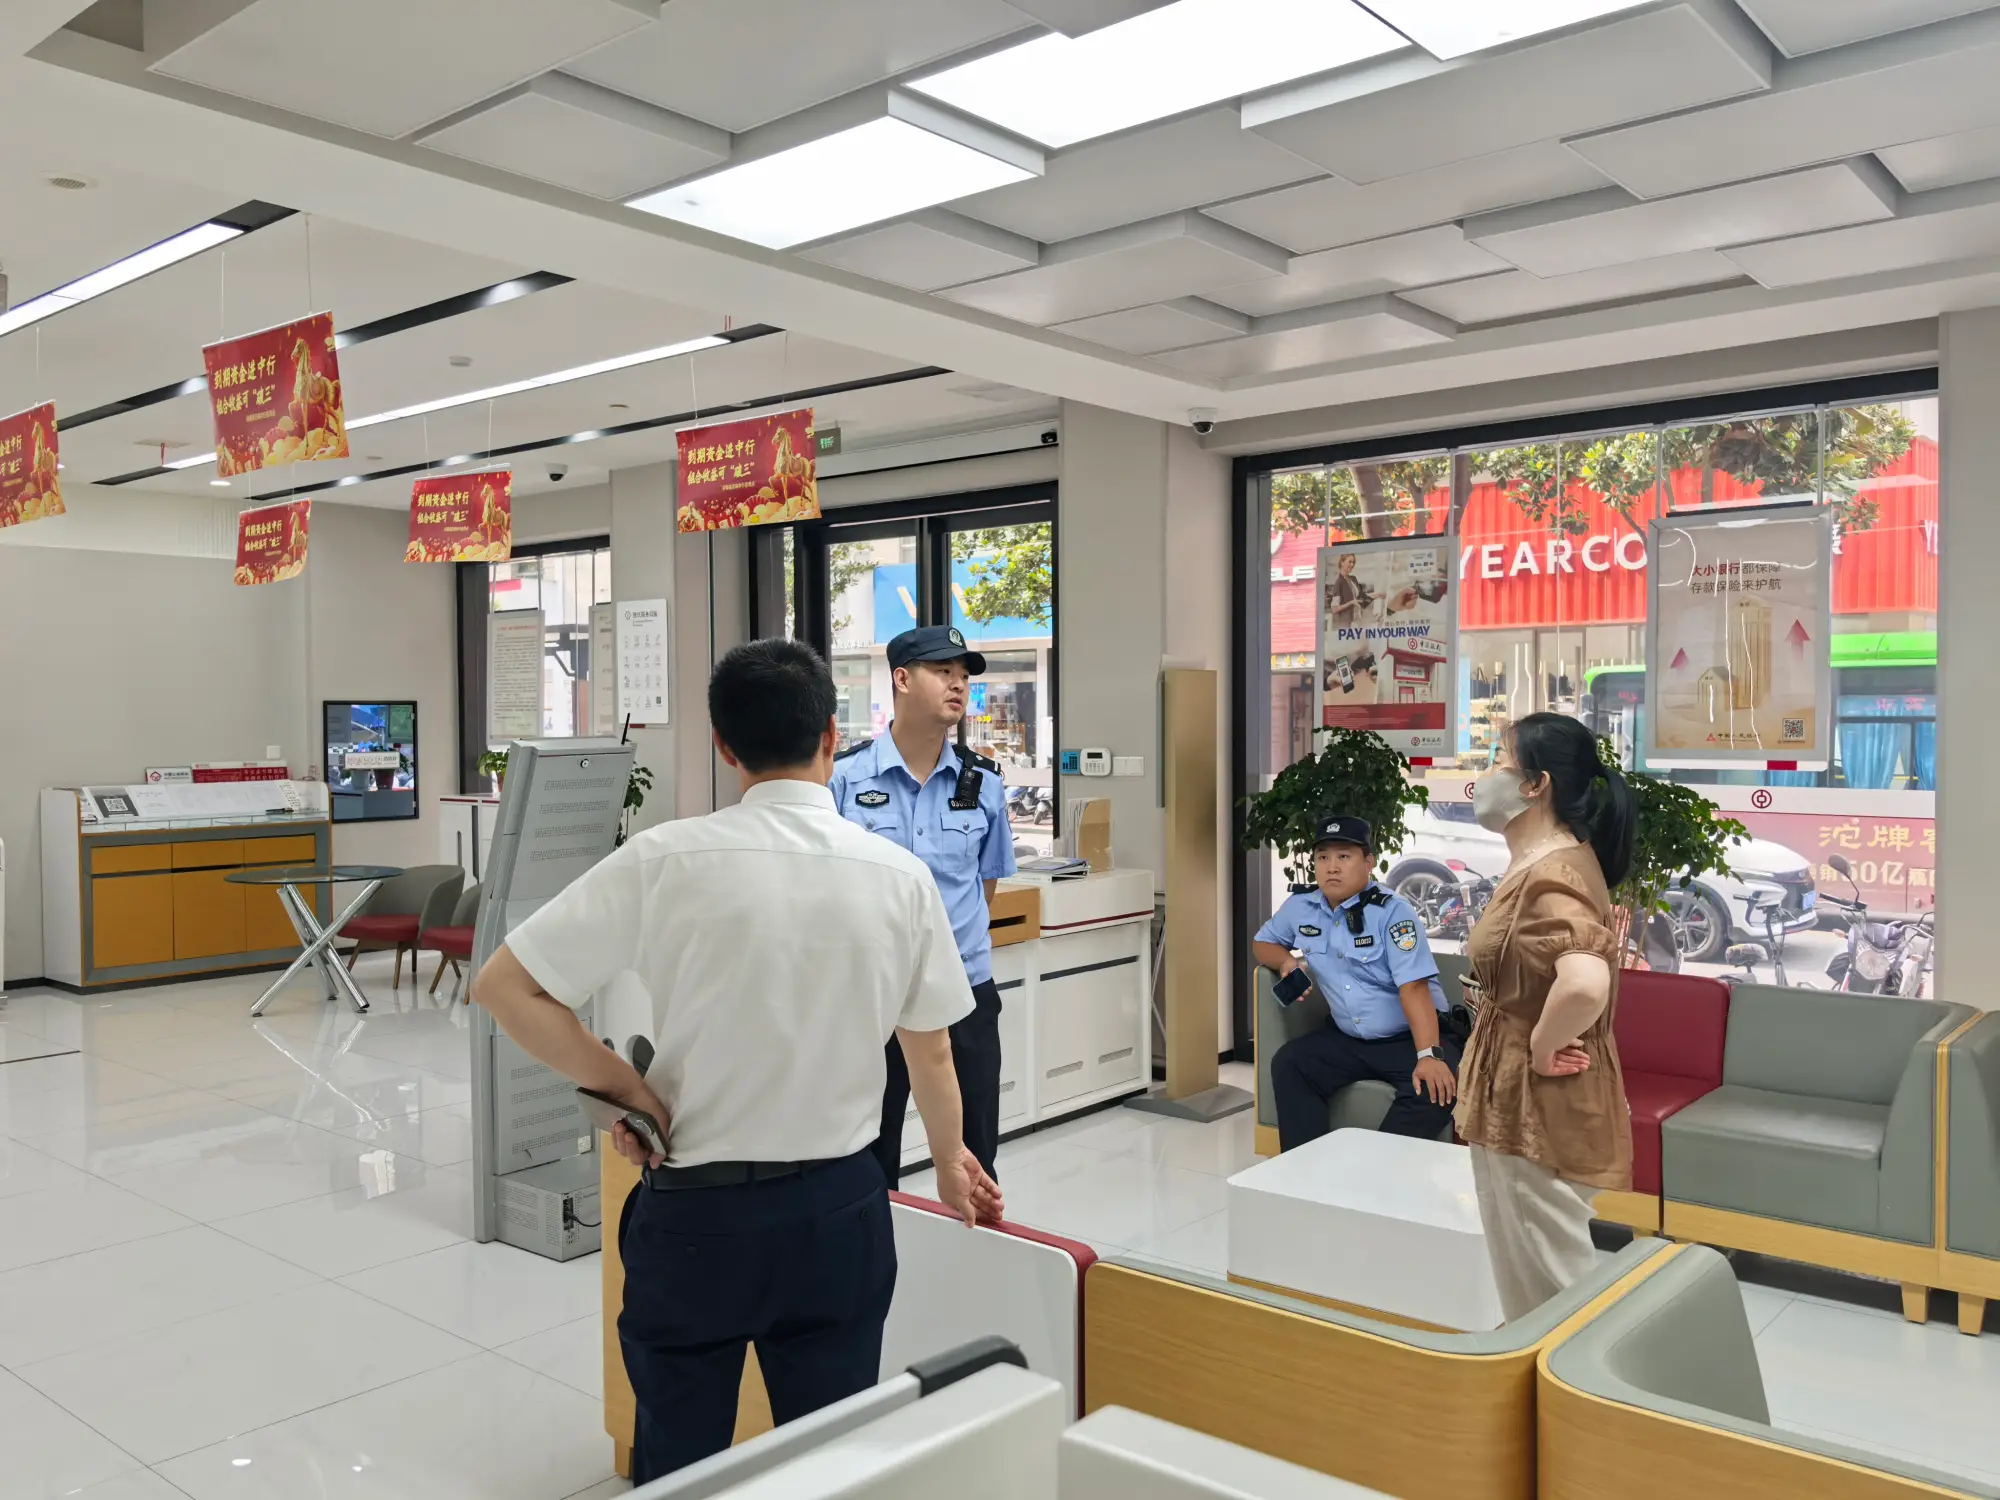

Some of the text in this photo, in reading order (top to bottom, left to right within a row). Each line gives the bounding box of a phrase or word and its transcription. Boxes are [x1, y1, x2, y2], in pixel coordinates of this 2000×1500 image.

[214, 355, 276, 390] 到期资金进中行
[688, 439, 756, 465] 到期资金进中行
[417, 491, 469, 507] 到期资金进中行
[1692, 562, 1781, 577] 大小银行都保障
[1691, 578, 1782, 594] 存款保险来护航
[1338, 625, 1430, 640] PAY IN YOUR WAY
